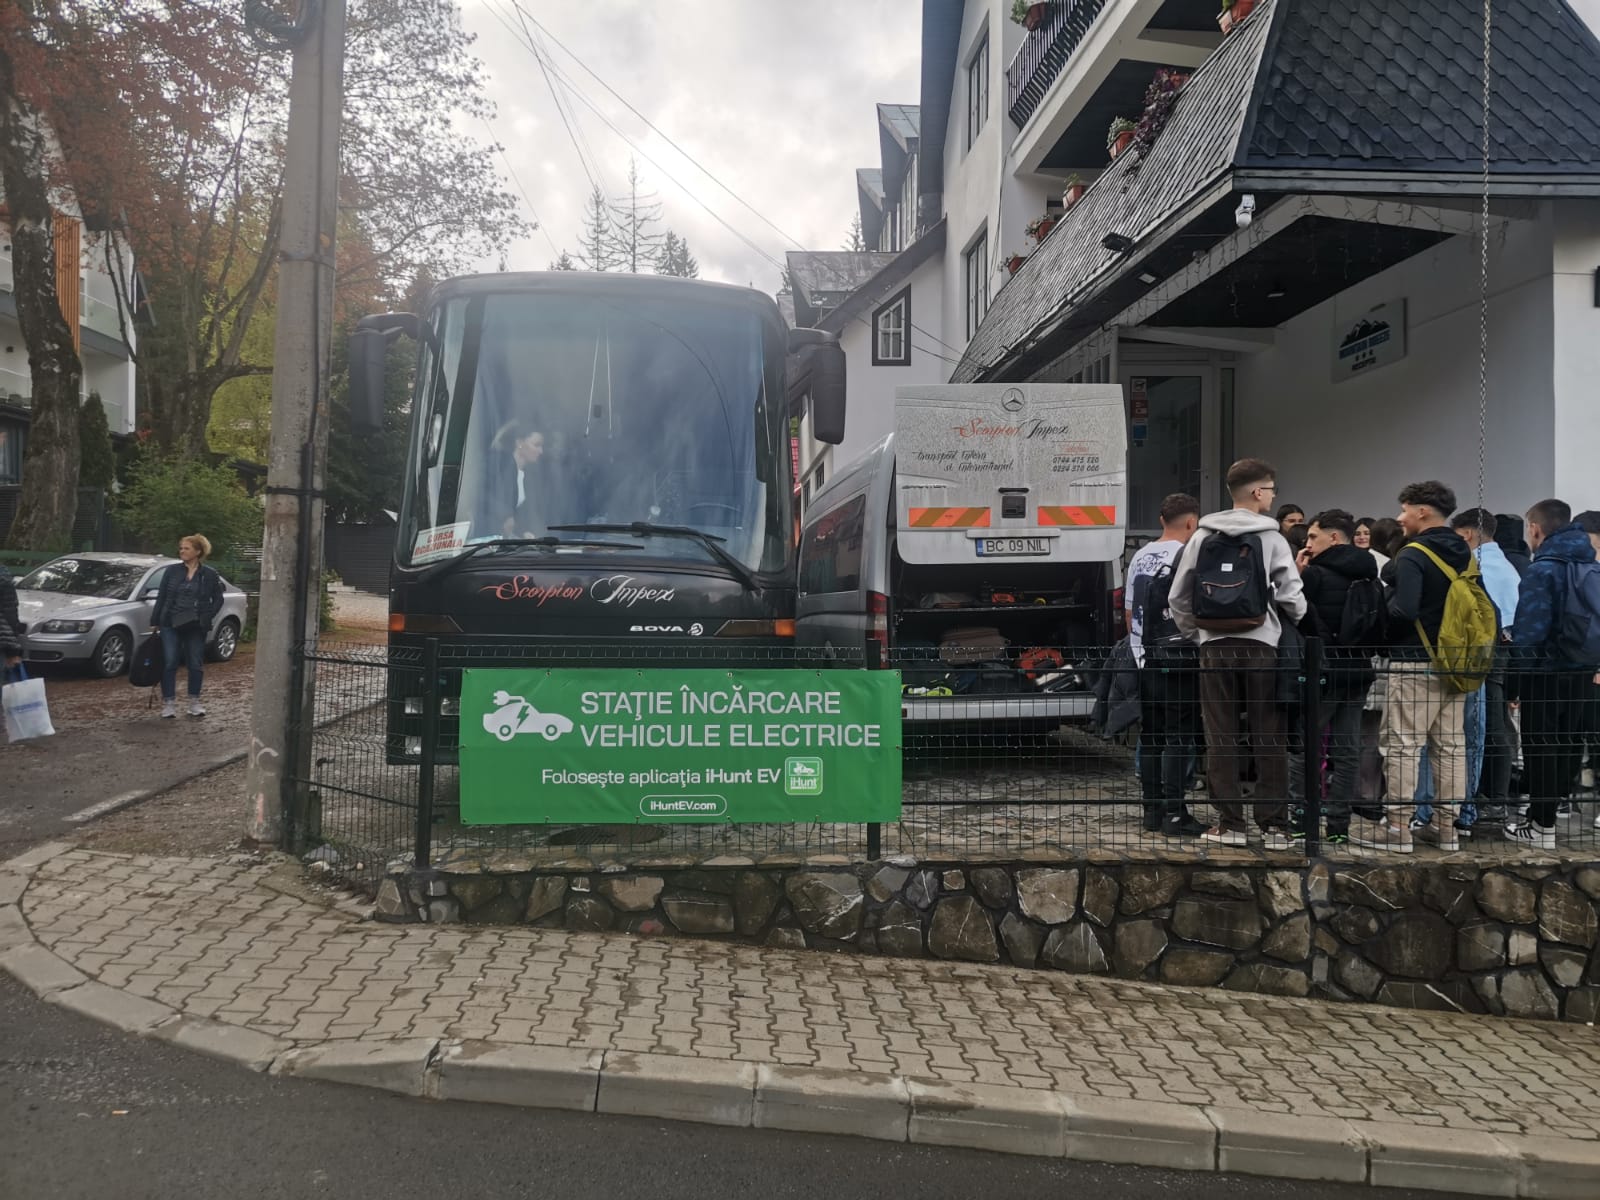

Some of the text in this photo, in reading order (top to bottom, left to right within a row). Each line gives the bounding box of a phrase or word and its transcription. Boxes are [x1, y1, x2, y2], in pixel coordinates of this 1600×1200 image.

[1019, 418, 1069, 439] Impex
[985, 539, 1046, 552] BC 09 NIL
[477, 574, 675, 608] Scorpion Impex
[580, 684, 841, 721] STAŢIE ÎNCĂRCARE
[580, 724, 881, 747] VEHICULE ELECTRICE
[705, 768, 753, 783] iHunt
[757, 768, 782, 783] EV
[790, 776, 817, 788] iHunt
[650, 800, 717, 811] iHuntEV.com
